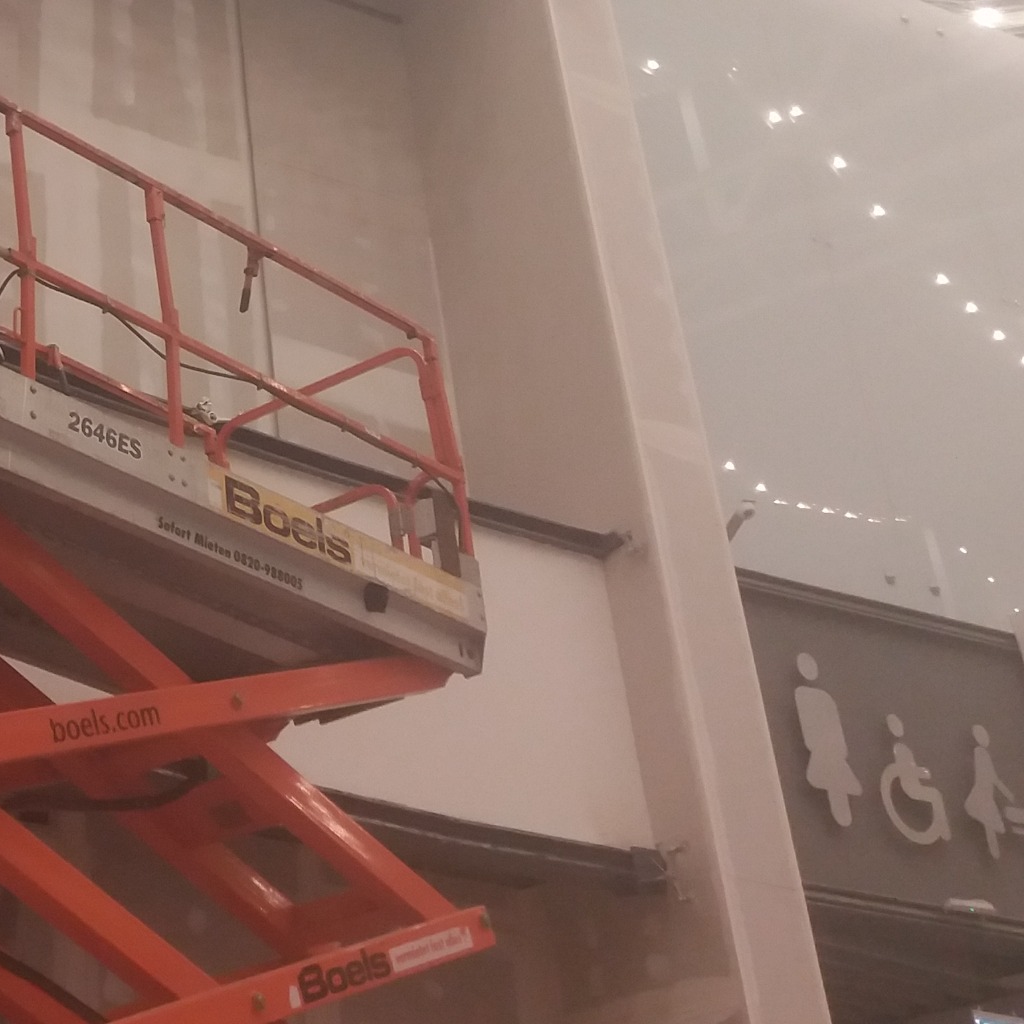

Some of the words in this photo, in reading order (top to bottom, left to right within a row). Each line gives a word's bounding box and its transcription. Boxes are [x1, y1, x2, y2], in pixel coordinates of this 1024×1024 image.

[68, 411, 142, 459] 2646ES
[224, 475, 352, 564] Boels
[194, 532, 231, 559] Mieten
[233, 549, 304, 591] 0820-988005
[49, 707, 161, 744] boels.com
[298, 947, 391, 1004] Boels
